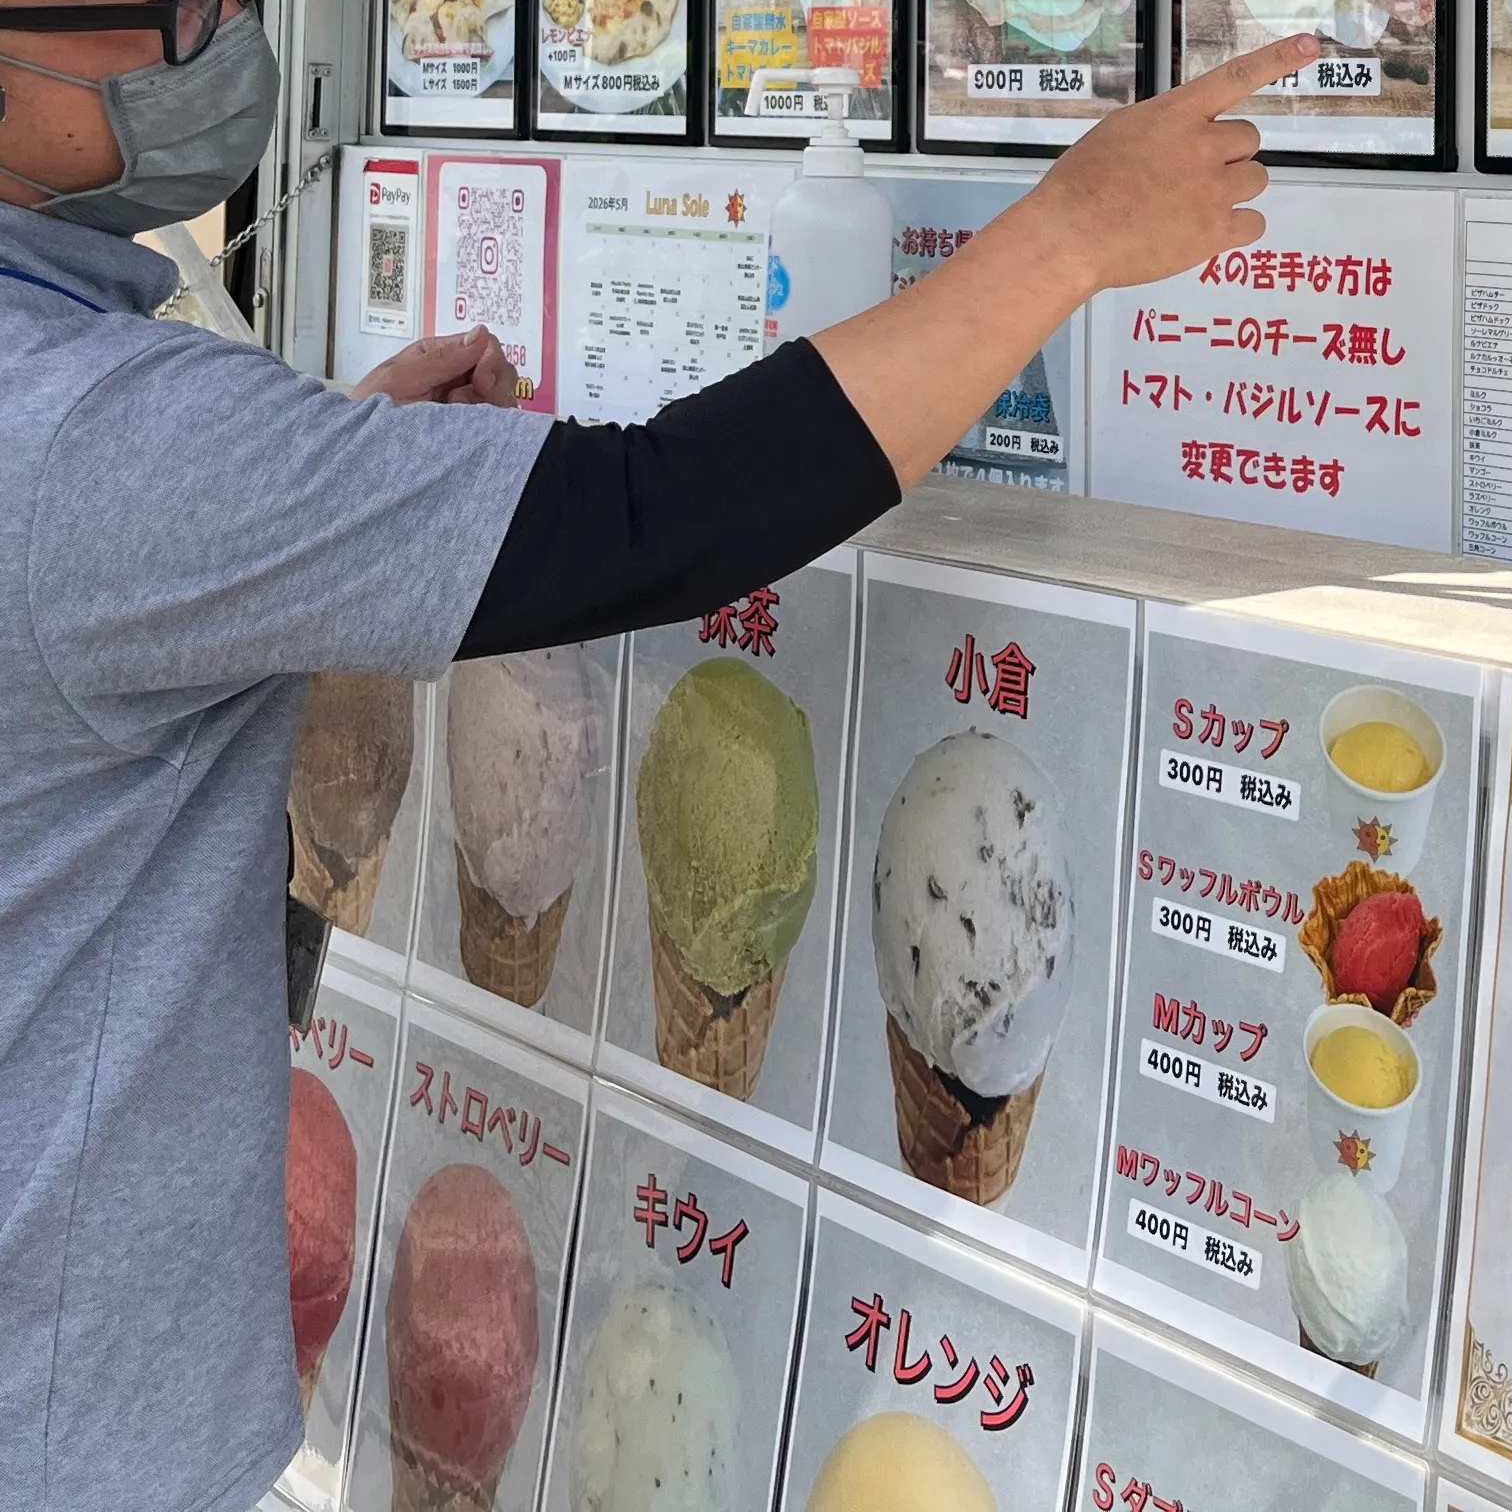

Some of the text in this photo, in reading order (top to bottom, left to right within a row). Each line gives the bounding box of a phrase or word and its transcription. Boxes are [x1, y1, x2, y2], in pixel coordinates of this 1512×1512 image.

[764, 94, 804, 111] 1000円
[974, 68, 1084, 92] 900円 税込み
[1317, 63, 1373, 88] 税込み
[382, 186, 411, 205] PayPay
[646, 190, 677, 216] Luna
[681, 192, 710, 218] Sole
[1200, 250, 1392, 296] ズの苦手な方は
[1133, 309, 1406, 366] パニーニのチーズ無し
[1122, 370, 1421, 437] トマト・バジルソースに
[990, 433, 1059, 455] 200円 税込み
[1181, 440, 1345, 498] 変更できます
[945, 633, 1036, 719] 小倉
[1173, 698, 1289, 759] Sカップ
[1167, 758, 1292, 810] 300円 税込み
[1138, 849, 1304, 925] Sワッフルボウル
[1160, 906, 1277, 961] 300円 税込み
[1153, 993, 1268, 1062] Mカップ
[1148, 1048, 1268, 1111] 400円 税込み
[410, 1061, 571, 1167] ストロベリー
[1116, 1144, 1300, 1242] Mワッフルコーン
[633, 1173, 749, 1289] キウイ
[1136, 1209, 1253, 1277] 400円 税込み
[844, 1292, 1035, 1431] オレンジ
